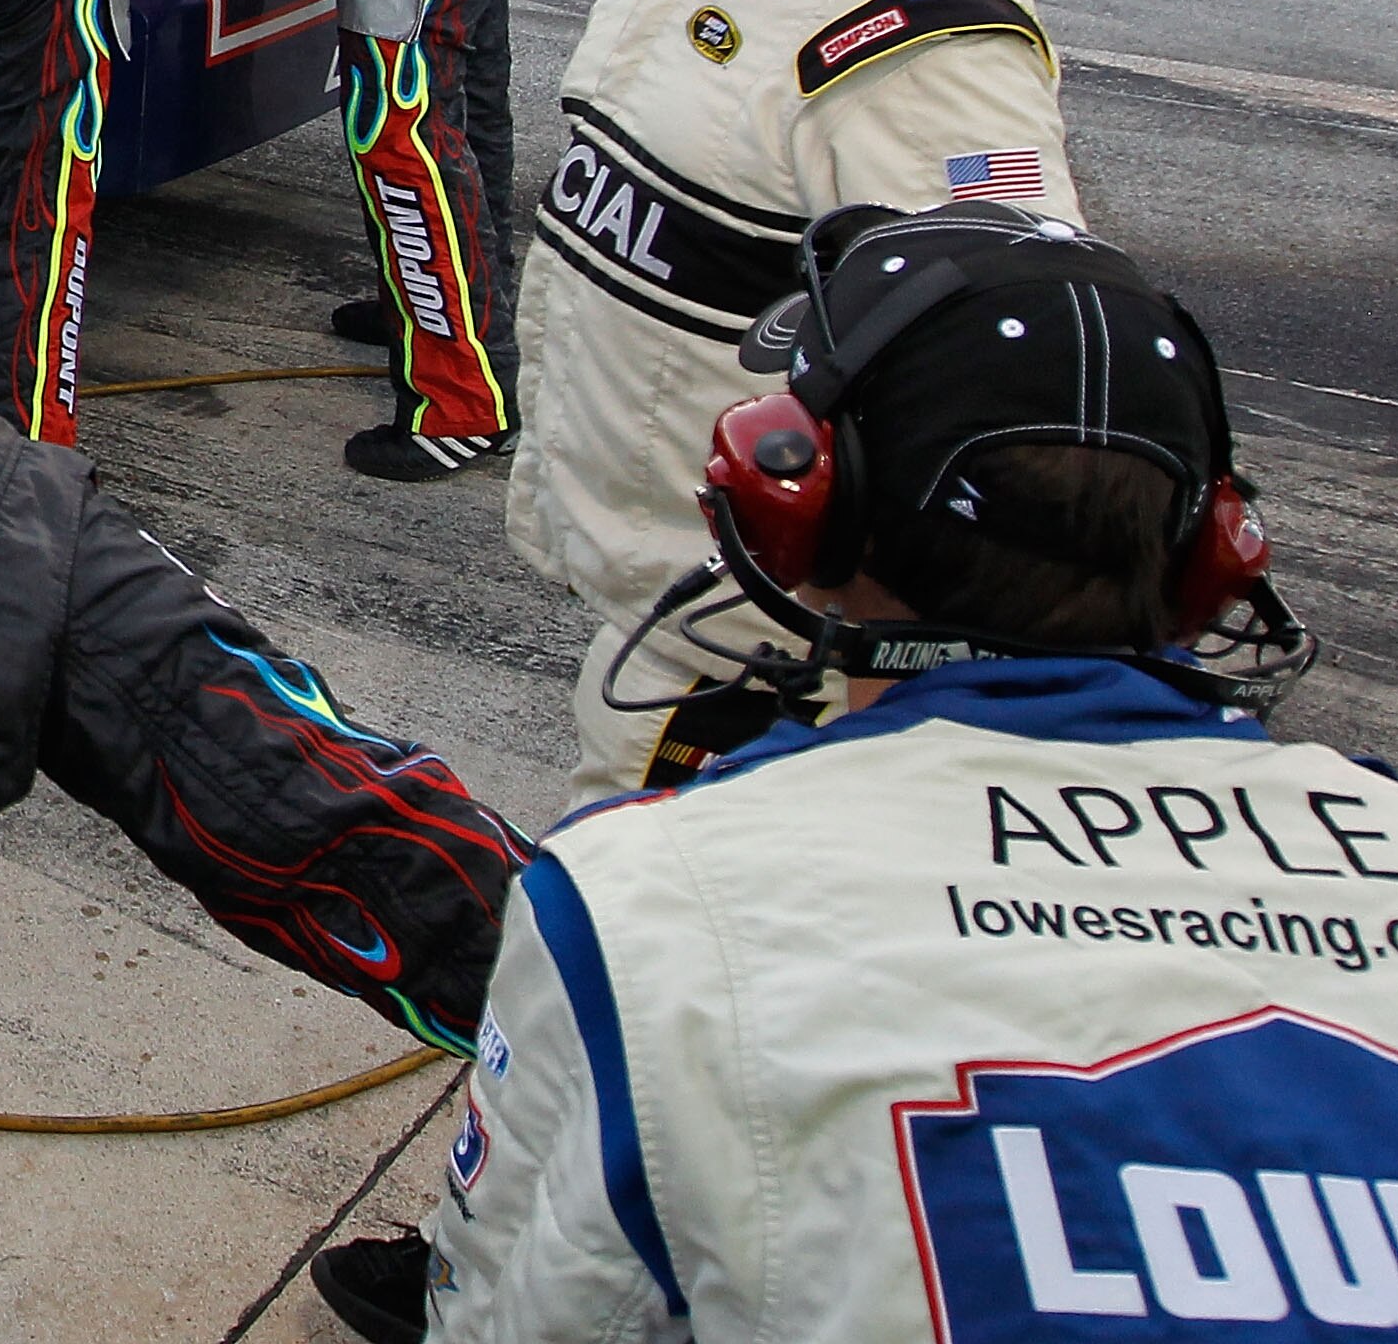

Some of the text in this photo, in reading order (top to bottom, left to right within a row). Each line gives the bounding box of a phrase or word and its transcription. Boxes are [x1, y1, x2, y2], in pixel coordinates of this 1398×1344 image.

[823, 10, 906, 65] SIMPSON
[381, 175, 452, 338] DUPONT
[552, 143, 673, 281] CIAL
[58, 236, 89, 414] DUPONT
[987, 785, 1398, 881] APPLE
